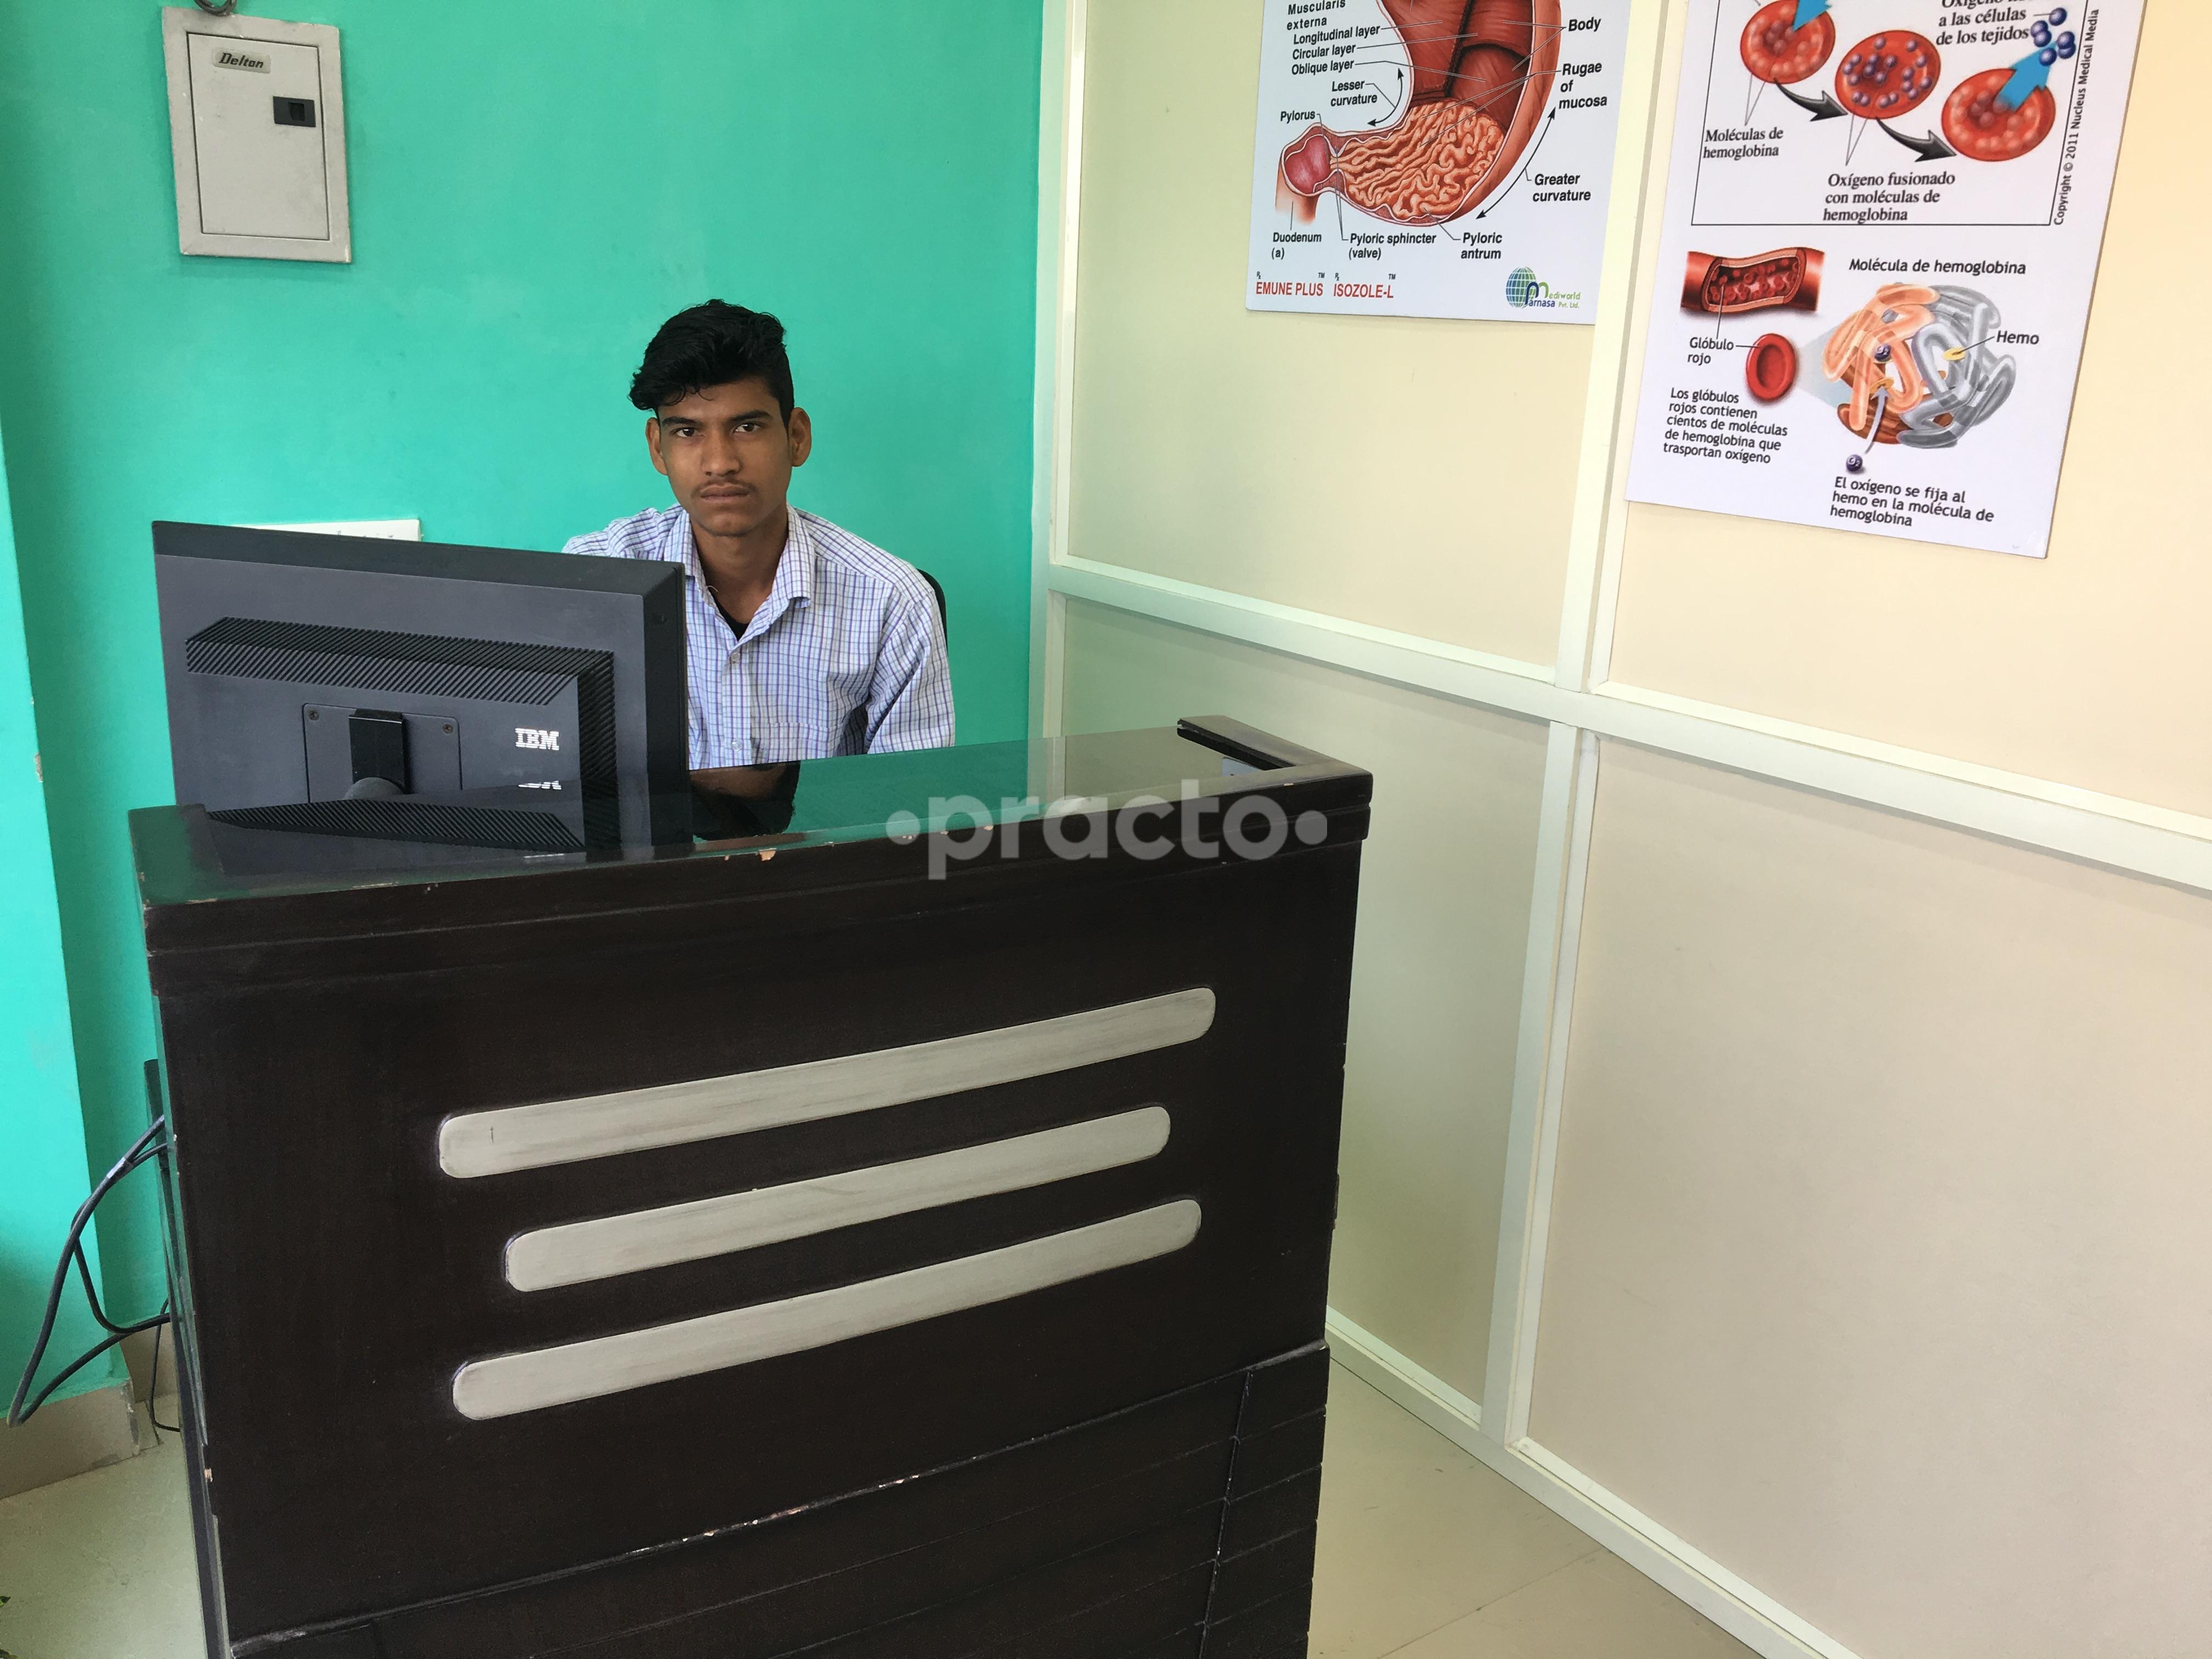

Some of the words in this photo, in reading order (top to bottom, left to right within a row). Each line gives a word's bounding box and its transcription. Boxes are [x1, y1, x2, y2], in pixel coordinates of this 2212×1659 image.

[1288, 0, 1346, 15] Muscularis
[1286, 16, 1327, 30] externa
[1568, 16, 1601, 32] Body
[1938, 16, 1946, 27] a
[1951, 12, 1971, 26] las
[1974, 7, 2027, 24] células
[2085, 9, 2099, 41] Media
[1293, 27, 1353, 45] Longitudinal
[1355, 25, 1380, 38] layer
[1936, 31, 1953, 45] de
[1956, 30, 1977, 44] los
[1980, 26, 2029, 45] tejidos
[1292, 44, 1329, 60] Circular
[1332, 44, 1356, 57] layer
[1291, 63, 1328, 75] Oblique
[1330, 60, 1355, 73] layer
[1562, 63, 1602, 77] Rugae
[2078, 44, 2093, 84] Medical
[1331, 81, 1365, 92] Lesser
[1560, 79, 1573, 93] of
[1330, 94, 1378, 106] curvature
[1559, 96, 1607, 109] mucosa
[2070, 88, 2086, 129] Nucleus
[1280, 110, 1316, 124] Pylorus
[1705, 127, 1765, 142] Moléculas
[1769, 126, 1784, 139] de
[1703, 143, 1779, 161] hemoglobina
[2066, 132, 2079, 159] 2011
[1534, 173, 1581, 185] Greater
[1828, 173, 1884, 190] Oxígeno
[1887, 171, 1955, 185] fusionado
[1532, 190, 1591, 202] curvature
[1825, 194, 1848, 204] con
[1852, 189, 1920, 204] moléculas
[1923, 189, 1940, 202] de
[2054, 175, 2072, 225] Copyright
[1822, 207, 1908, 224] hemoglobina
[1273, 232, 1322, 242] Duodenum
[1350, 233, 1385, 246] Pyloric
[1387, 234, 1436, 246] sphincter
[1463, 232, 1503, 246] Pyloric
[1271, 247, 1285, 260] (a)
[1348, 247, 1381, 261] (valve)
[1460, 248, 1502, 259] antrum
[1849, 258, 1908, 272] Molécula
[1912, 259, 1930, 272] de
[1934, 259, 2026, 276] hemoglobina
[1256, 281, 1293, 295] EMUNE
[1295, 283, 1323, 296] PLUS
[1334, 284, 1394, 298] ISOZOLE-L
[1690, 337, 1734, 350] Glóbulo
[1996, 330, 2039, 345] Hemo
[1688, 353, 1711, 366] rojo
[1671, 387, 1689, 399] Los
[1692, 389, 1739, 403] glóbulos
[1669, 403, 1696, 415] rojos
[1700, 406, 1757, 419] contienen
[1667, 415, 1707, 428] cientos
[1711, 419, 1725, 430] de
[1729, 421, 1787, 436] moléculas
[1664, 429, 1679, 439] de
[1683, 430, 1755, 448] hemoglobina
[1759, 439, 1781, 452] que
[1663, 443, 1722, 458] trasportan
[1725, 449, 1771, 464] oxígeno
[1835, 476, 1847, 488] El
[1850, 478, 1901, 495] oxígeno
[1905, 487, 1920, 497] se
[1925, 487, 1948, 502] fija
[1952, 491, 1966, 503] al
[1832, 490, 1868, 505] hemo
[1871, 498, 1887, 508] en
[1892, 498, 1904, 510] la
[1908, 501, 1971, 519] molécula
[1976, 509, 1995, 522] de
[1830, 505, 1912, 527] hemoglobina
[515, 728, 559, 751] IBM
